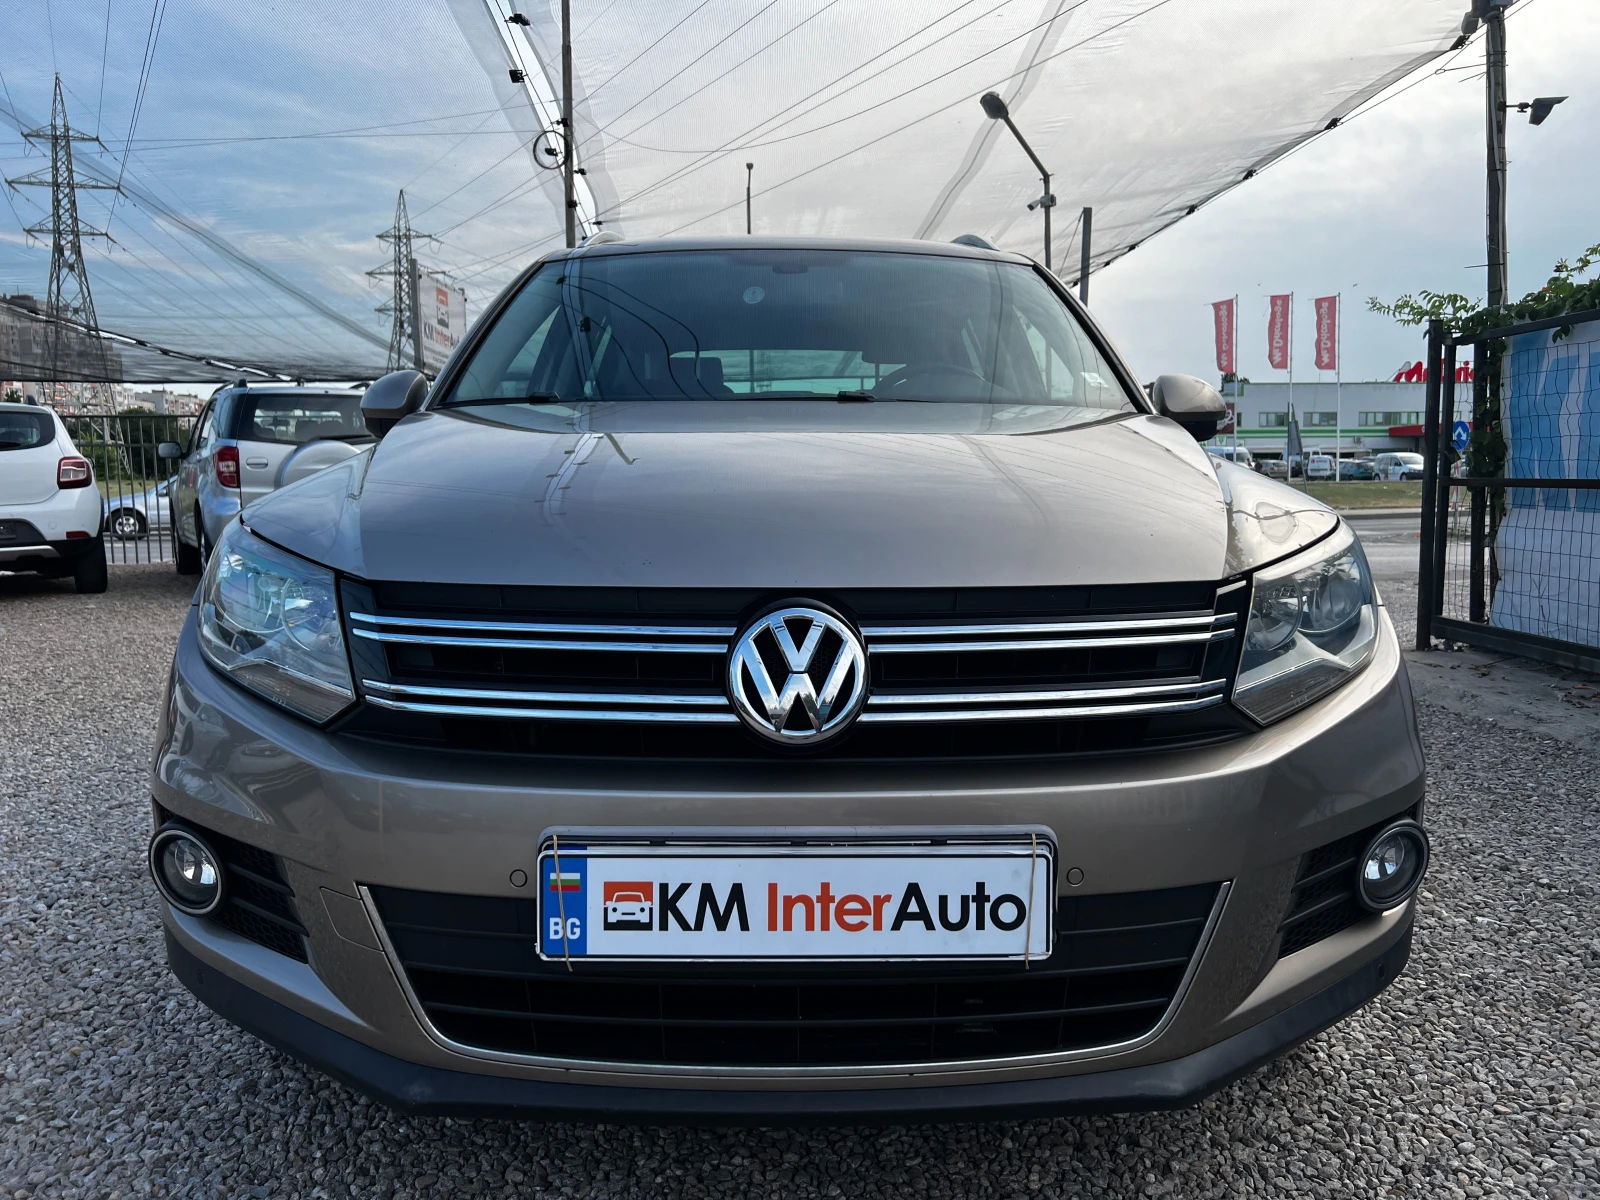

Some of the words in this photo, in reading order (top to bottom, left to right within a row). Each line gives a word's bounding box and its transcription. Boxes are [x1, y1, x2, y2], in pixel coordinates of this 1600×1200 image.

[658, 882, 750, 932] KM
[767, 881, 1027, 932] InterAuto
[549, 917, 581, 940] BG
